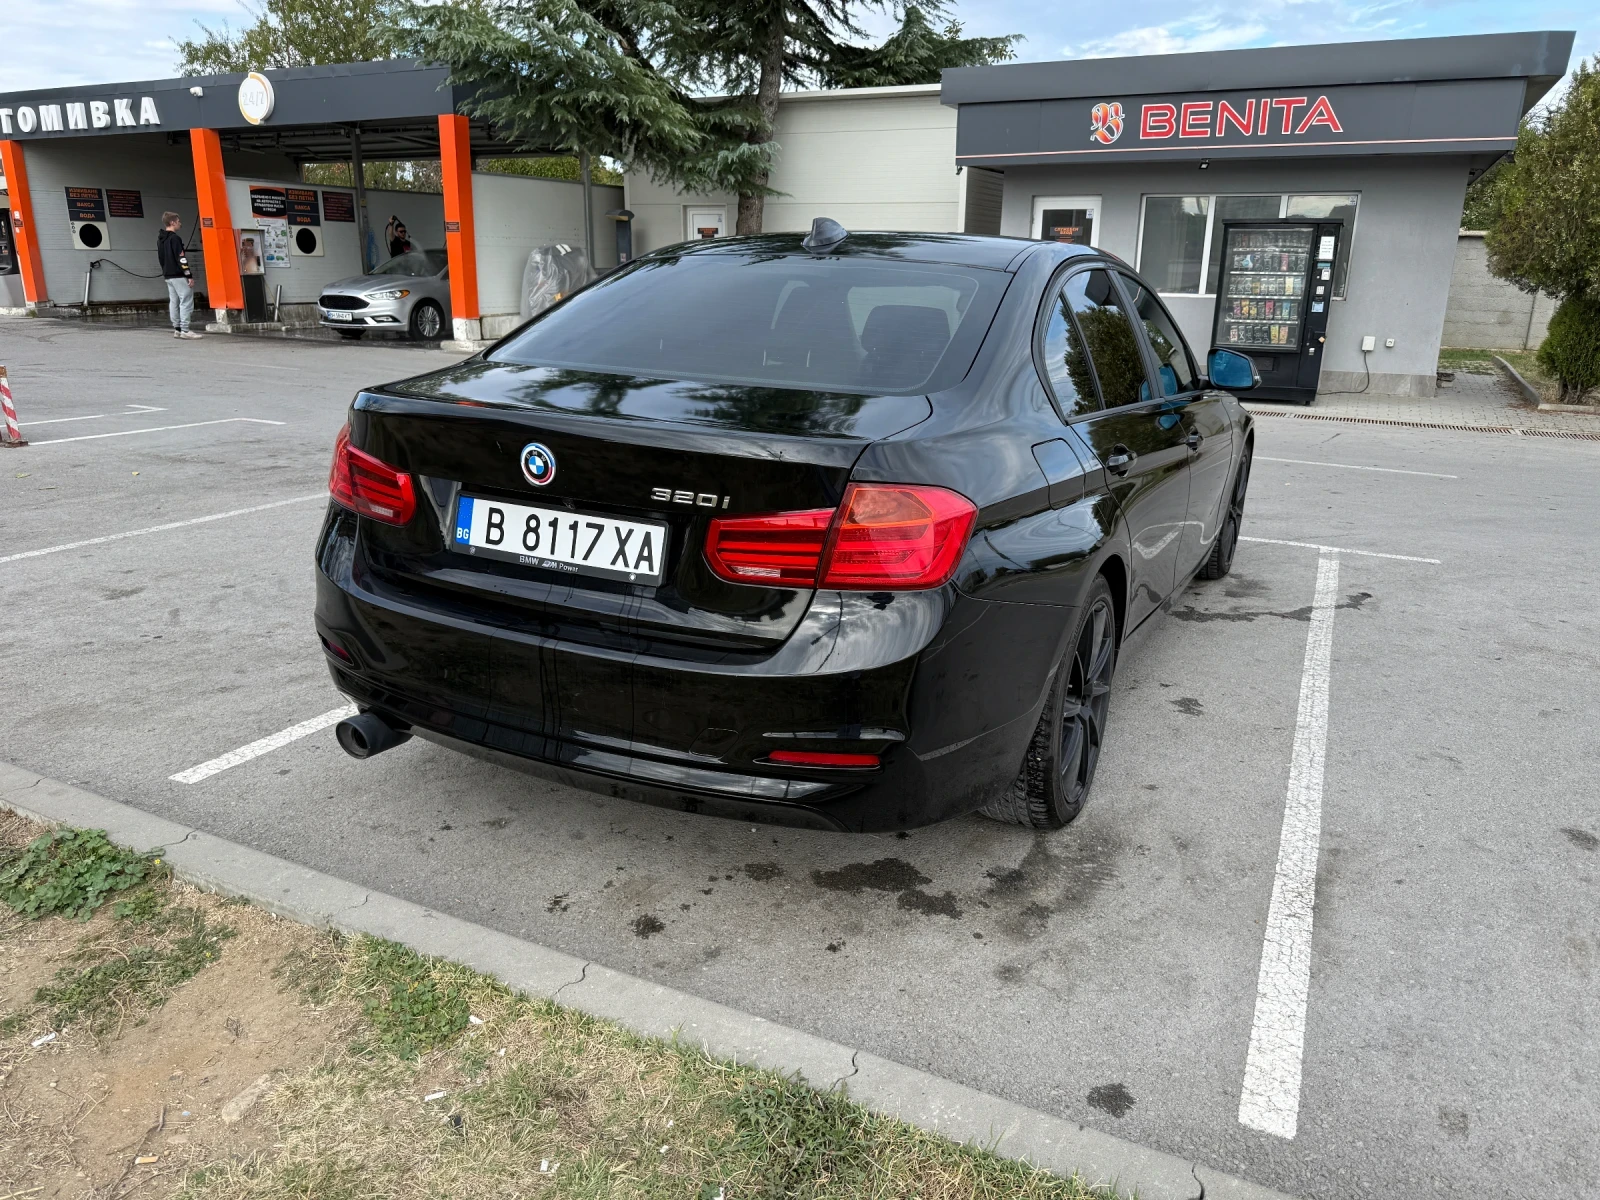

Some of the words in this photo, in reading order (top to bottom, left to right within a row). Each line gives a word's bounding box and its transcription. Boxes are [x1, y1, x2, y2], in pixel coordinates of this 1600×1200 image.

[242, 91, 265, 107] 24/7
[1139, 95, 1344, 140] BENITA
[650, 487, 731, 509] 320i
[456, 526, 470, 540] BG
[485, 507, 505, 546] B
[522, 514, 605, 561] 8117
[610, 526, 654, 573] XA
[519, 555, 540, 566] BMW
[558, 563, 579, 573] Power
